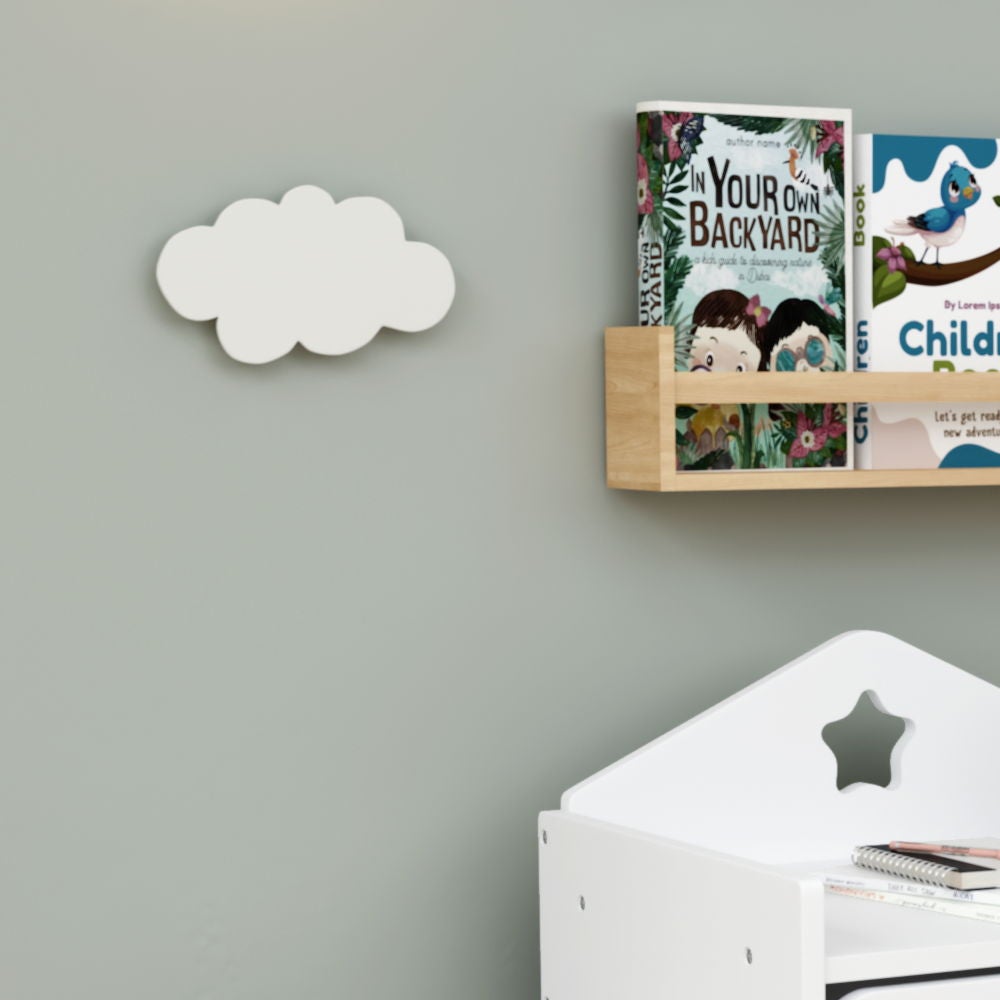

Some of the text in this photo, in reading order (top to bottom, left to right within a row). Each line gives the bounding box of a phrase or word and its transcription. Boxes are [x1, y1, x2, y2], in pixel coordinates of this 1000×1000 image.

[726, 136, 781, 148] author name
[690, 155, 820, 215] IN YOUR OWN
[689, 200, 820, 254] BACKYARD
[853, 184, 865, 247] Book
[649, 242, 663, 327] KYARD
[944, 300, 955, 311] By
[958, 301, 986, 310] Lorem
[934, 410, 957, 422] Let's
[960, 411, 977, 425] get
[943, 428, 962, 438] new
